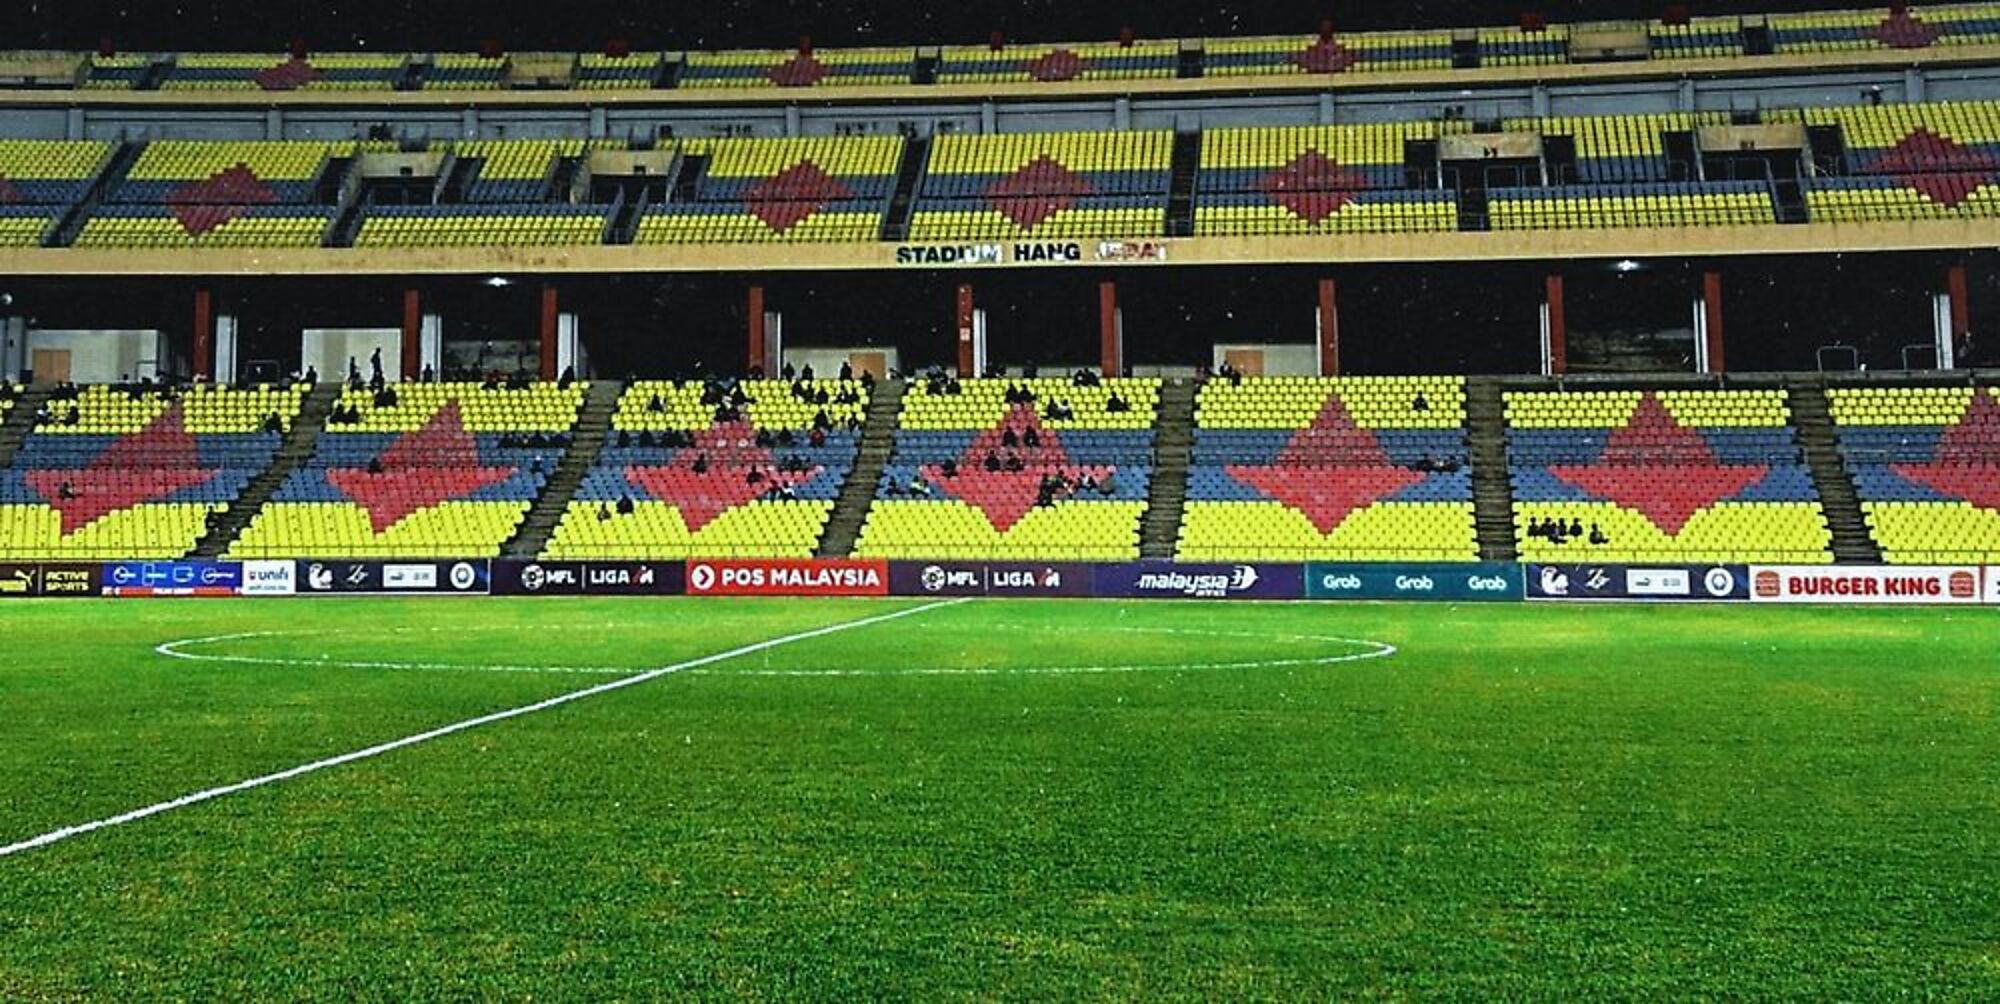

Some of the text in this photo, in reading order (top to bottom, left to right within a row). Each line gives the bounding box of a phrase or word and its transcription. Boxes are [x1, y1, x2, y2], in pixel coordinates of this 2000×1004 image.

[896, 244, 1003, 264] STADIUM
[1013, 243, 1081, 261] HANG
[45, 571, 89, 581] ACTIVE
[546, 570, 577, 584] MFL
[590, 569, 630, 584] LIGA
[721, 569, 881, 587] POS MALAYSIA
[947, 571, 979, 586] MFL
[993, 571, 1035, 587] LIGA
[1138, 572, 1229, 593] malaysia
[1323, 574, 1361, 590] Grab
[1395, 575, 1434, 590] Grab
[1467, 575, 1507, 591] Grab
[45, 582, 89, 591] SPORTS
[1788, 576, 1879, 595] BURGER
[1884, 577, 1941, 595] KING
